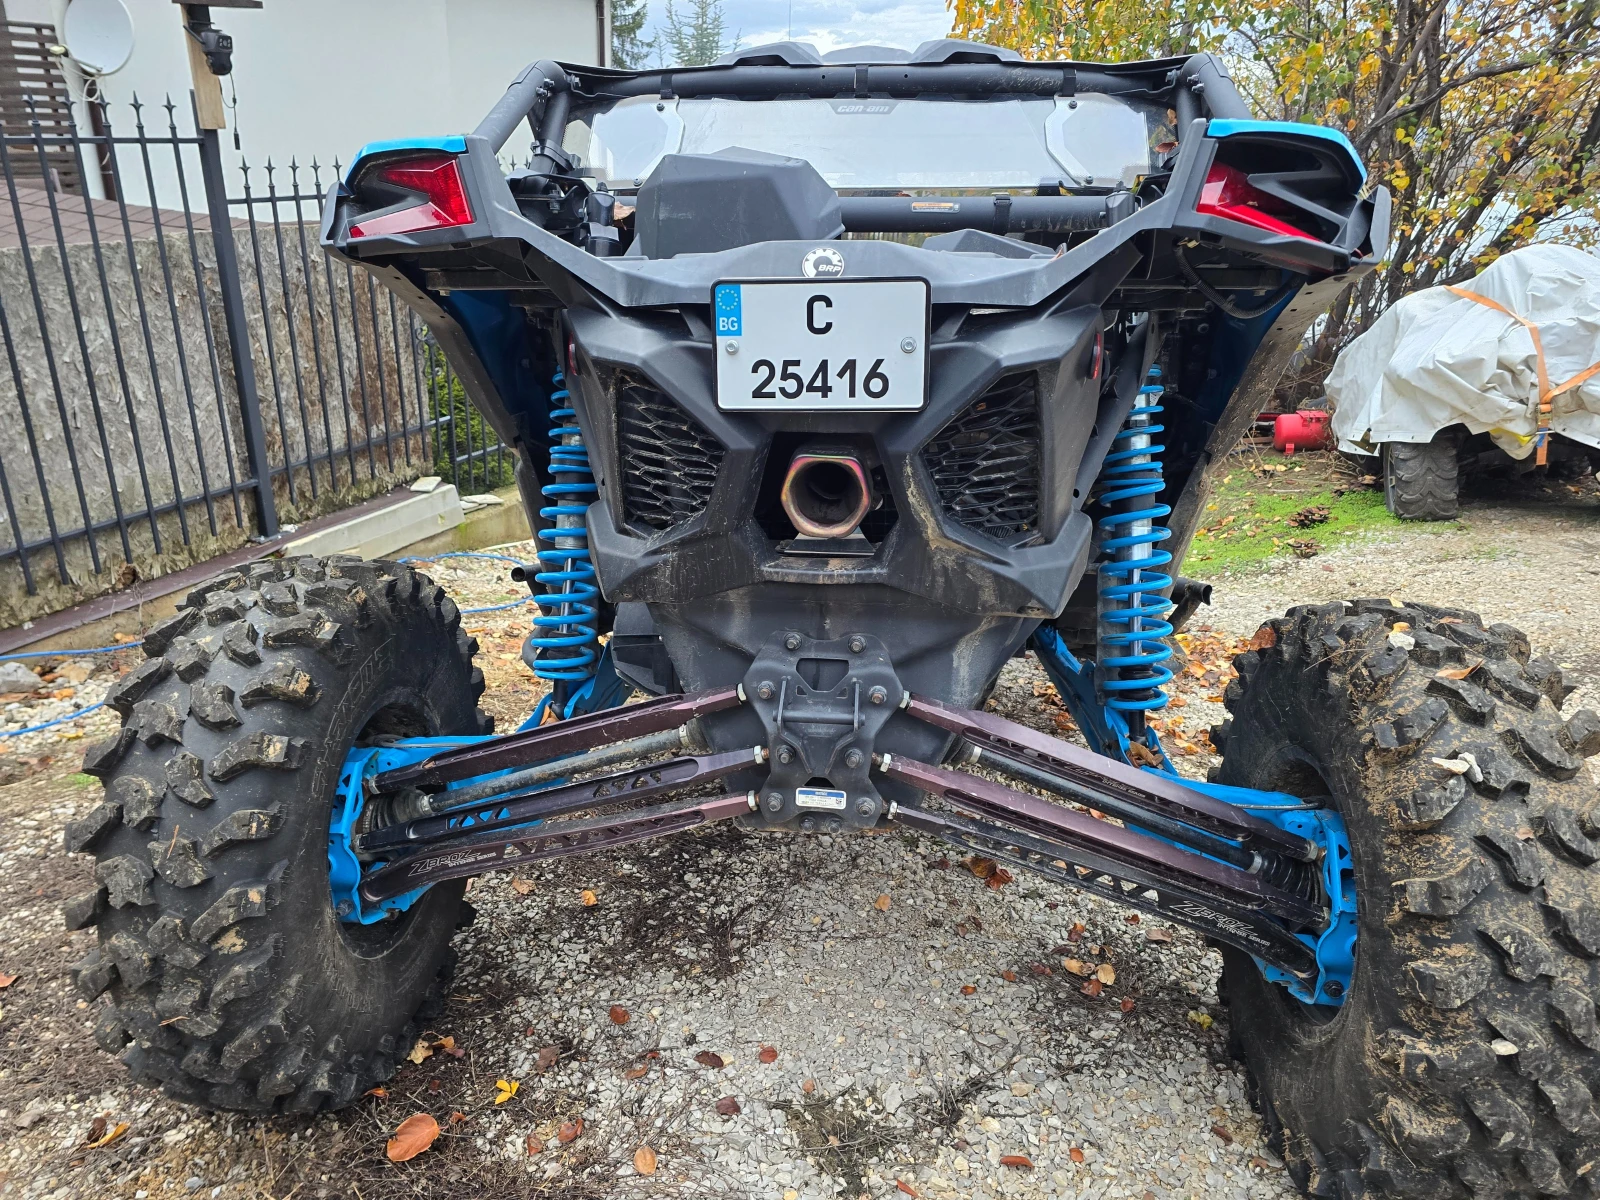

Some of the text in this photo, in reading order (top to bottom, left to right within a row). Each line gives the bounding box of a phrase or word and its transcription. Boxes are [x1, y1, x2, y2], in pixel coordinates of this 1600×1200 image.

[818, 264, 841, 273] BRP
[719, 317, 738, 331] BG
[806, 294, 833, 335] C
[751, 358, 890, 399] 25416
